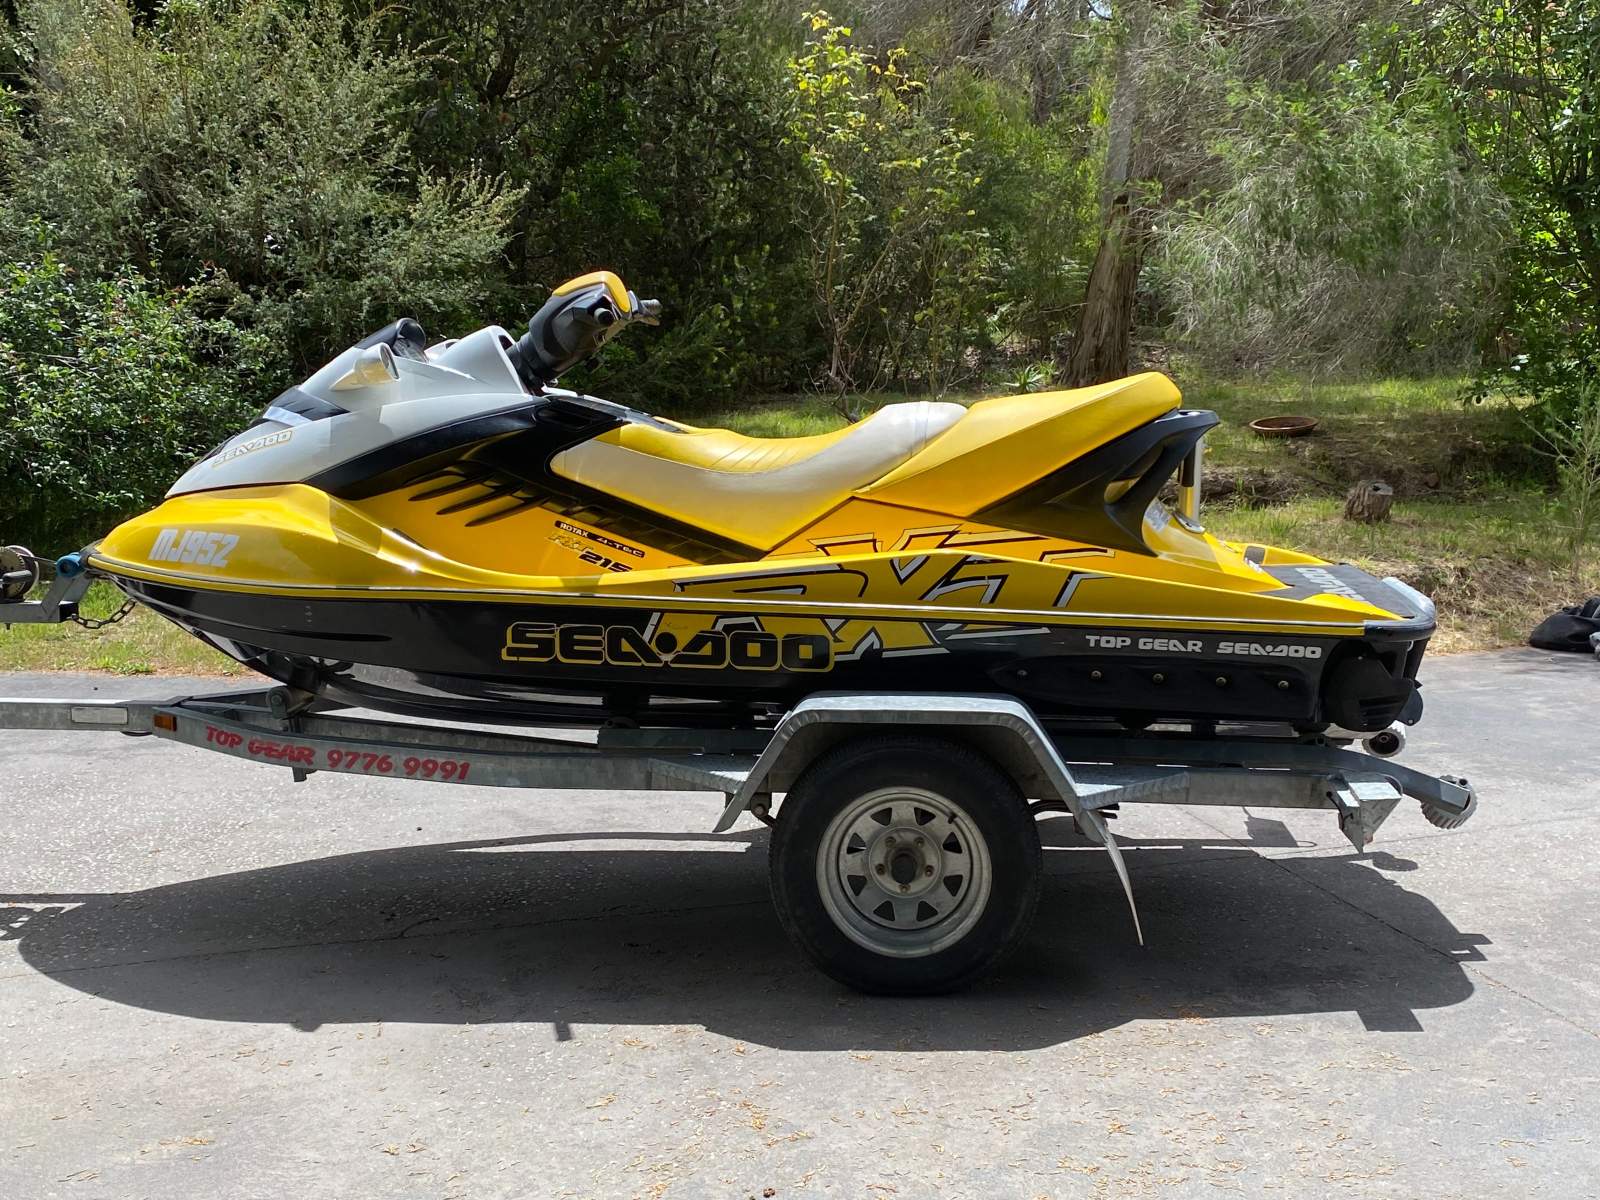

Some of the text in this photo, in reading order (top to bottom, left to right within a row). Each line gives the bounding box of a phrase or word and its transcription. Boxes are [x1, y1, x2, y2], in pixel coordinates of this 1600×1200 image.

[560, 522, 589, 538] ROTAX
[148, 528, 240, 568] MJ952
[578, 550, 633, 573] 215
[1085, 634, 1132, 649] TOP
[1137, 637, 1203, 653] GEAR
[205, 725, 471, 780] TOP GEAR 9776 9991
